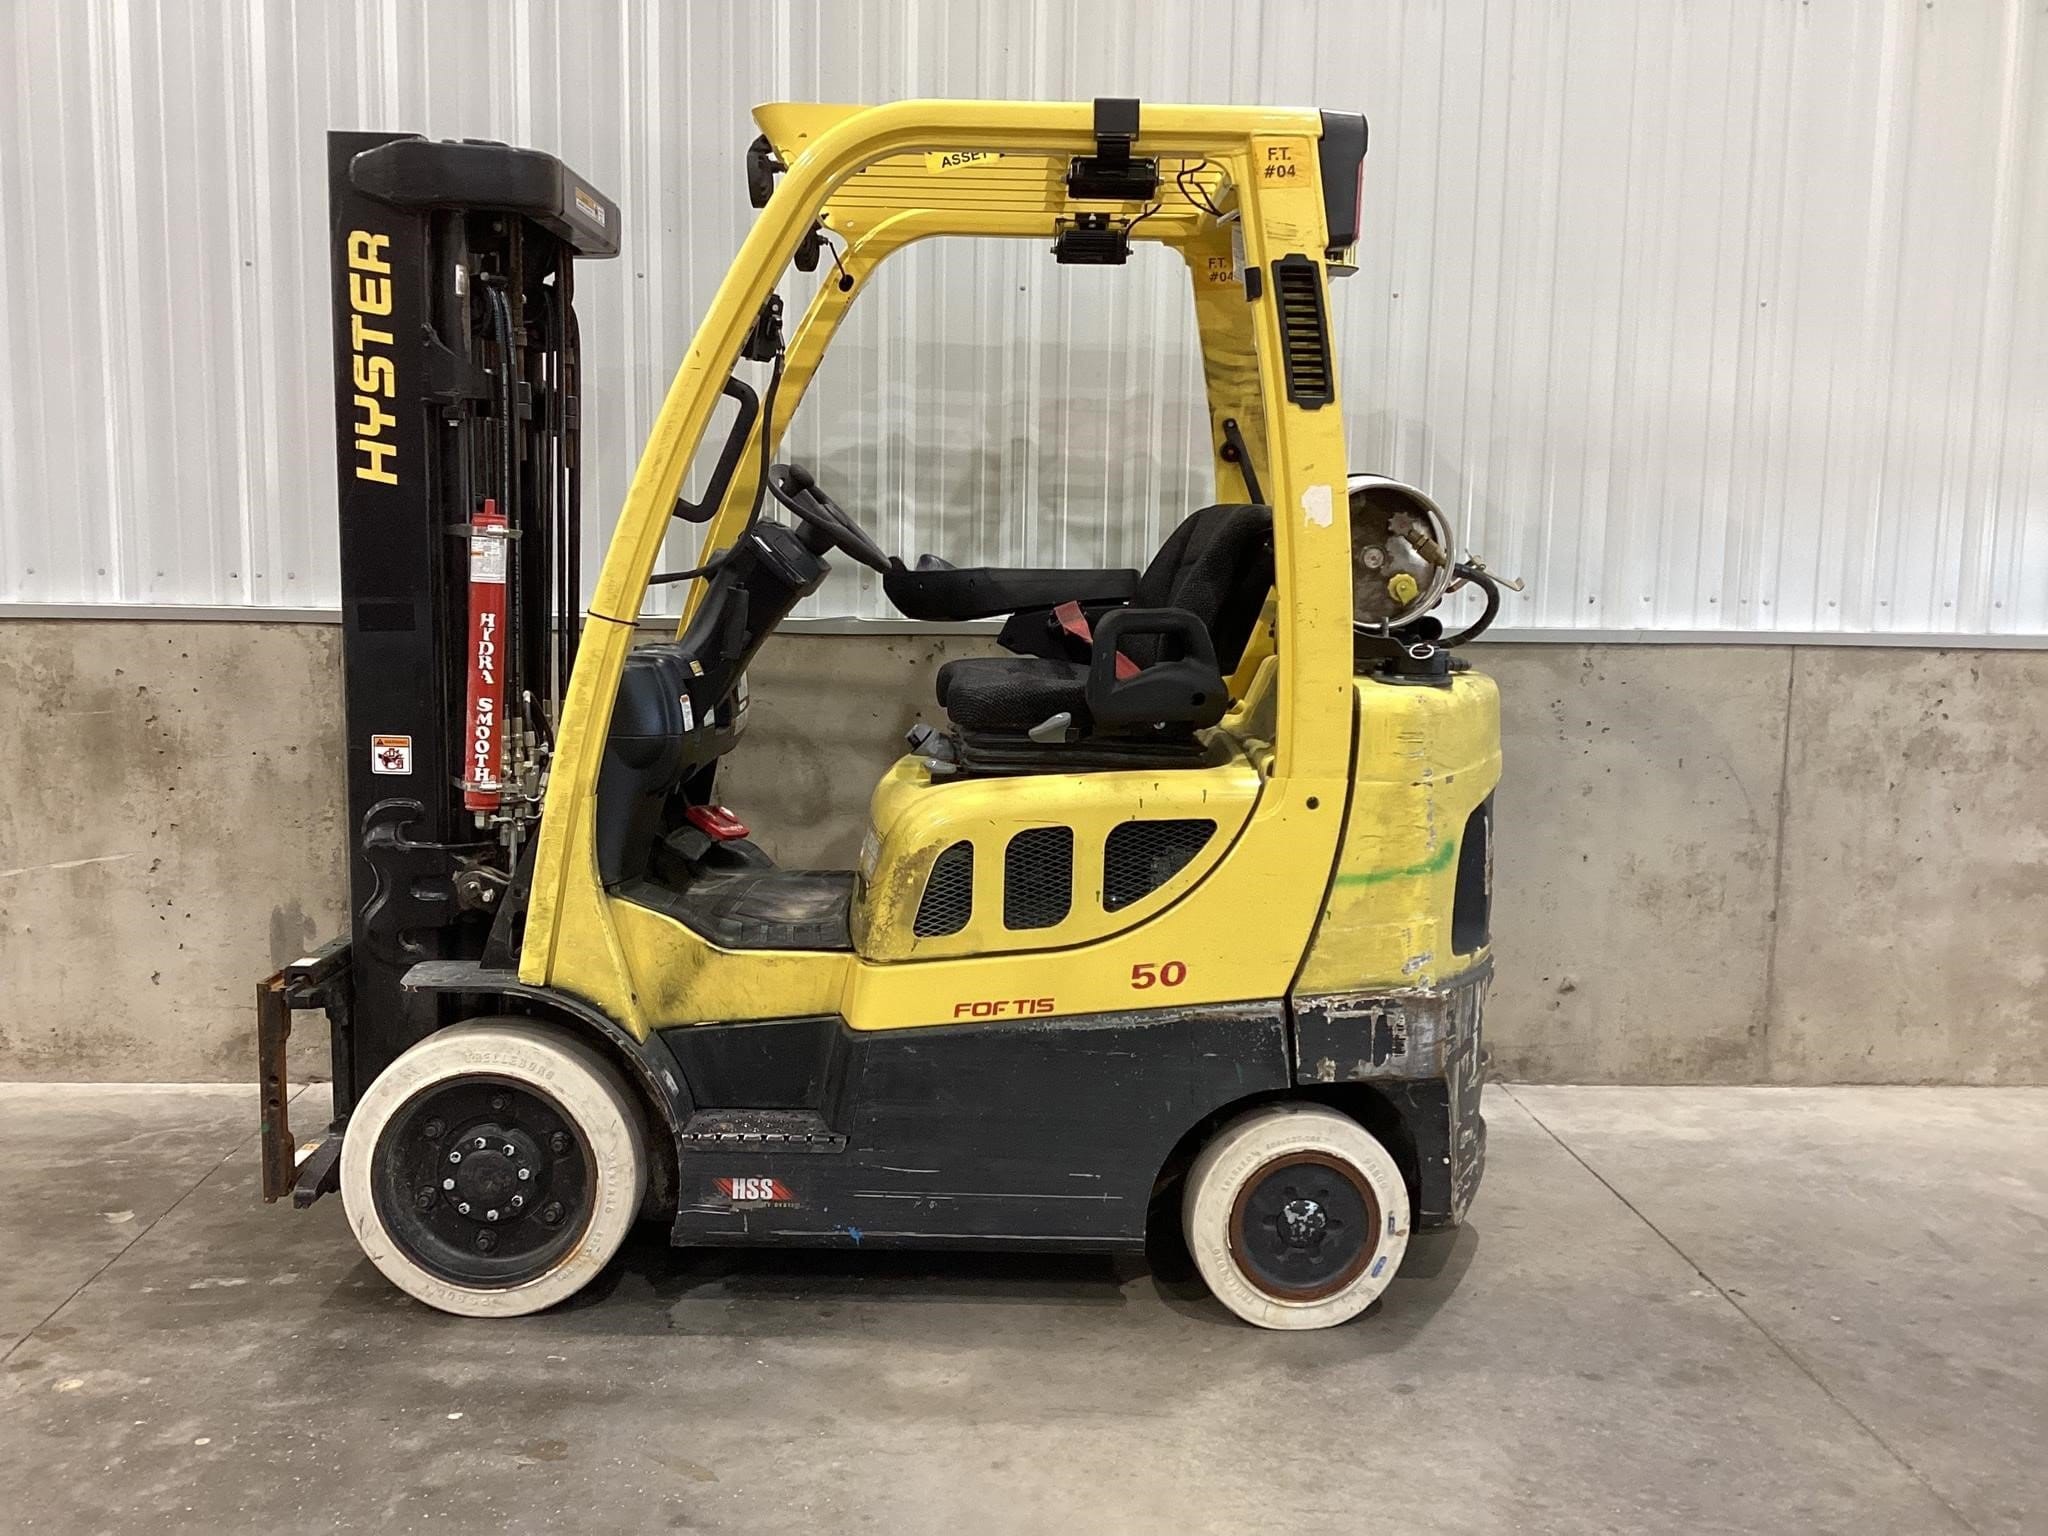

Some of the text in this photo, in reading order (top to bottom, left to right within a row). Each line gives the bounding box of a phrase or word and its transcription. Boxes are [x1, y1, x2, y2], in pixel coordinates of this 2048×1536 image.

[1267, 147, 1292, 161] F.T.
[1264, 164, 1297, 179] #04
[348, 231, 398, 485] HYSTER
[475, 614, 496, 783] HYDRA SMOOTH
[1132, 961, 1187, 988] 50
[732, 1177, 774, 1200] HSS
